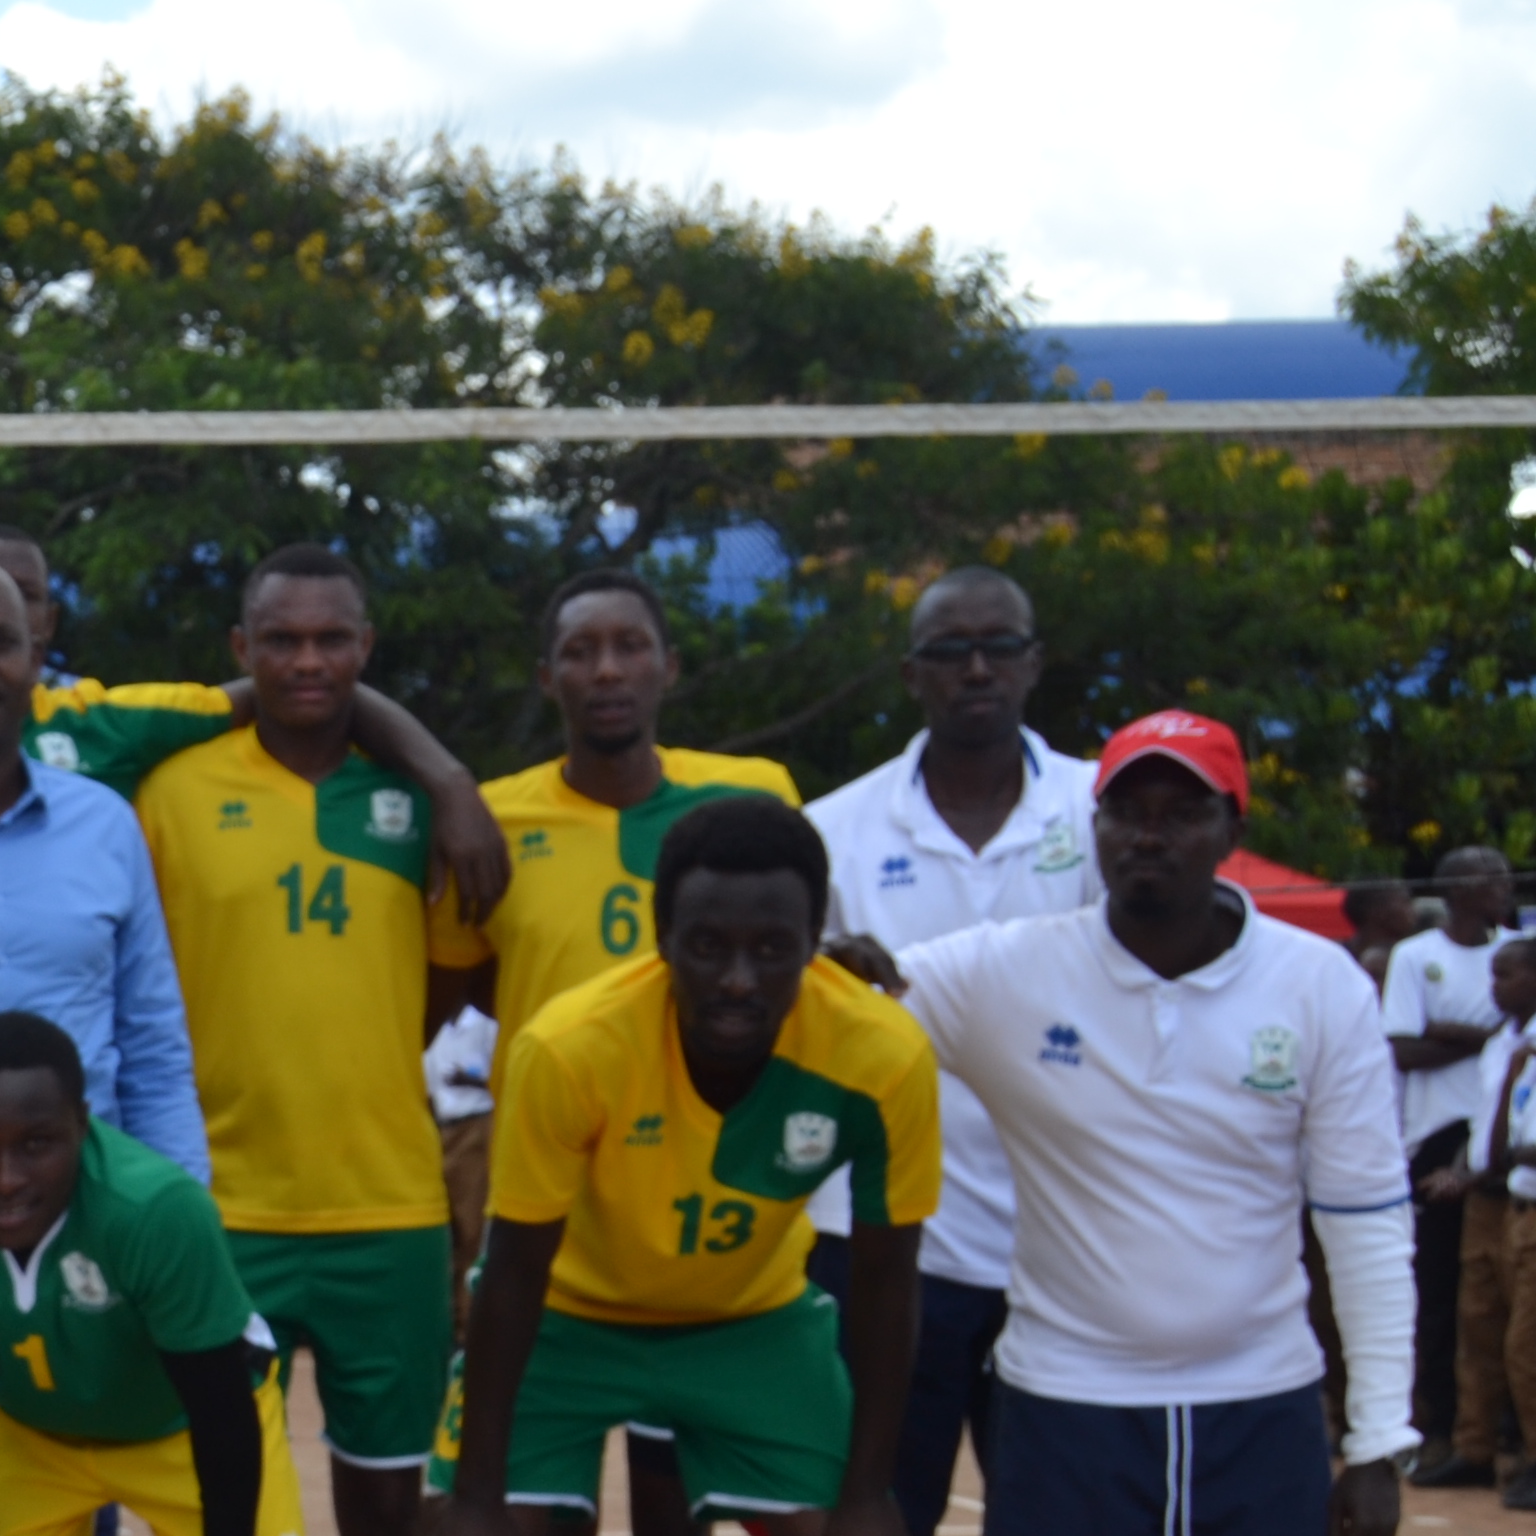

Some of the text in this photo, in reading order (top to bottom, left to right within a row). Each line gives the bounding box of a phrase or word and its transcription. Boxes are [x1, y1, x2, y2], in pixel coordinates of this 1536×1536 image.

[277, 863, 351, 936] 14
[600, 883, 641, 957] 6
[672, 1191, 756, 1256] 13
[12, 1334, 56, 1391] 1
